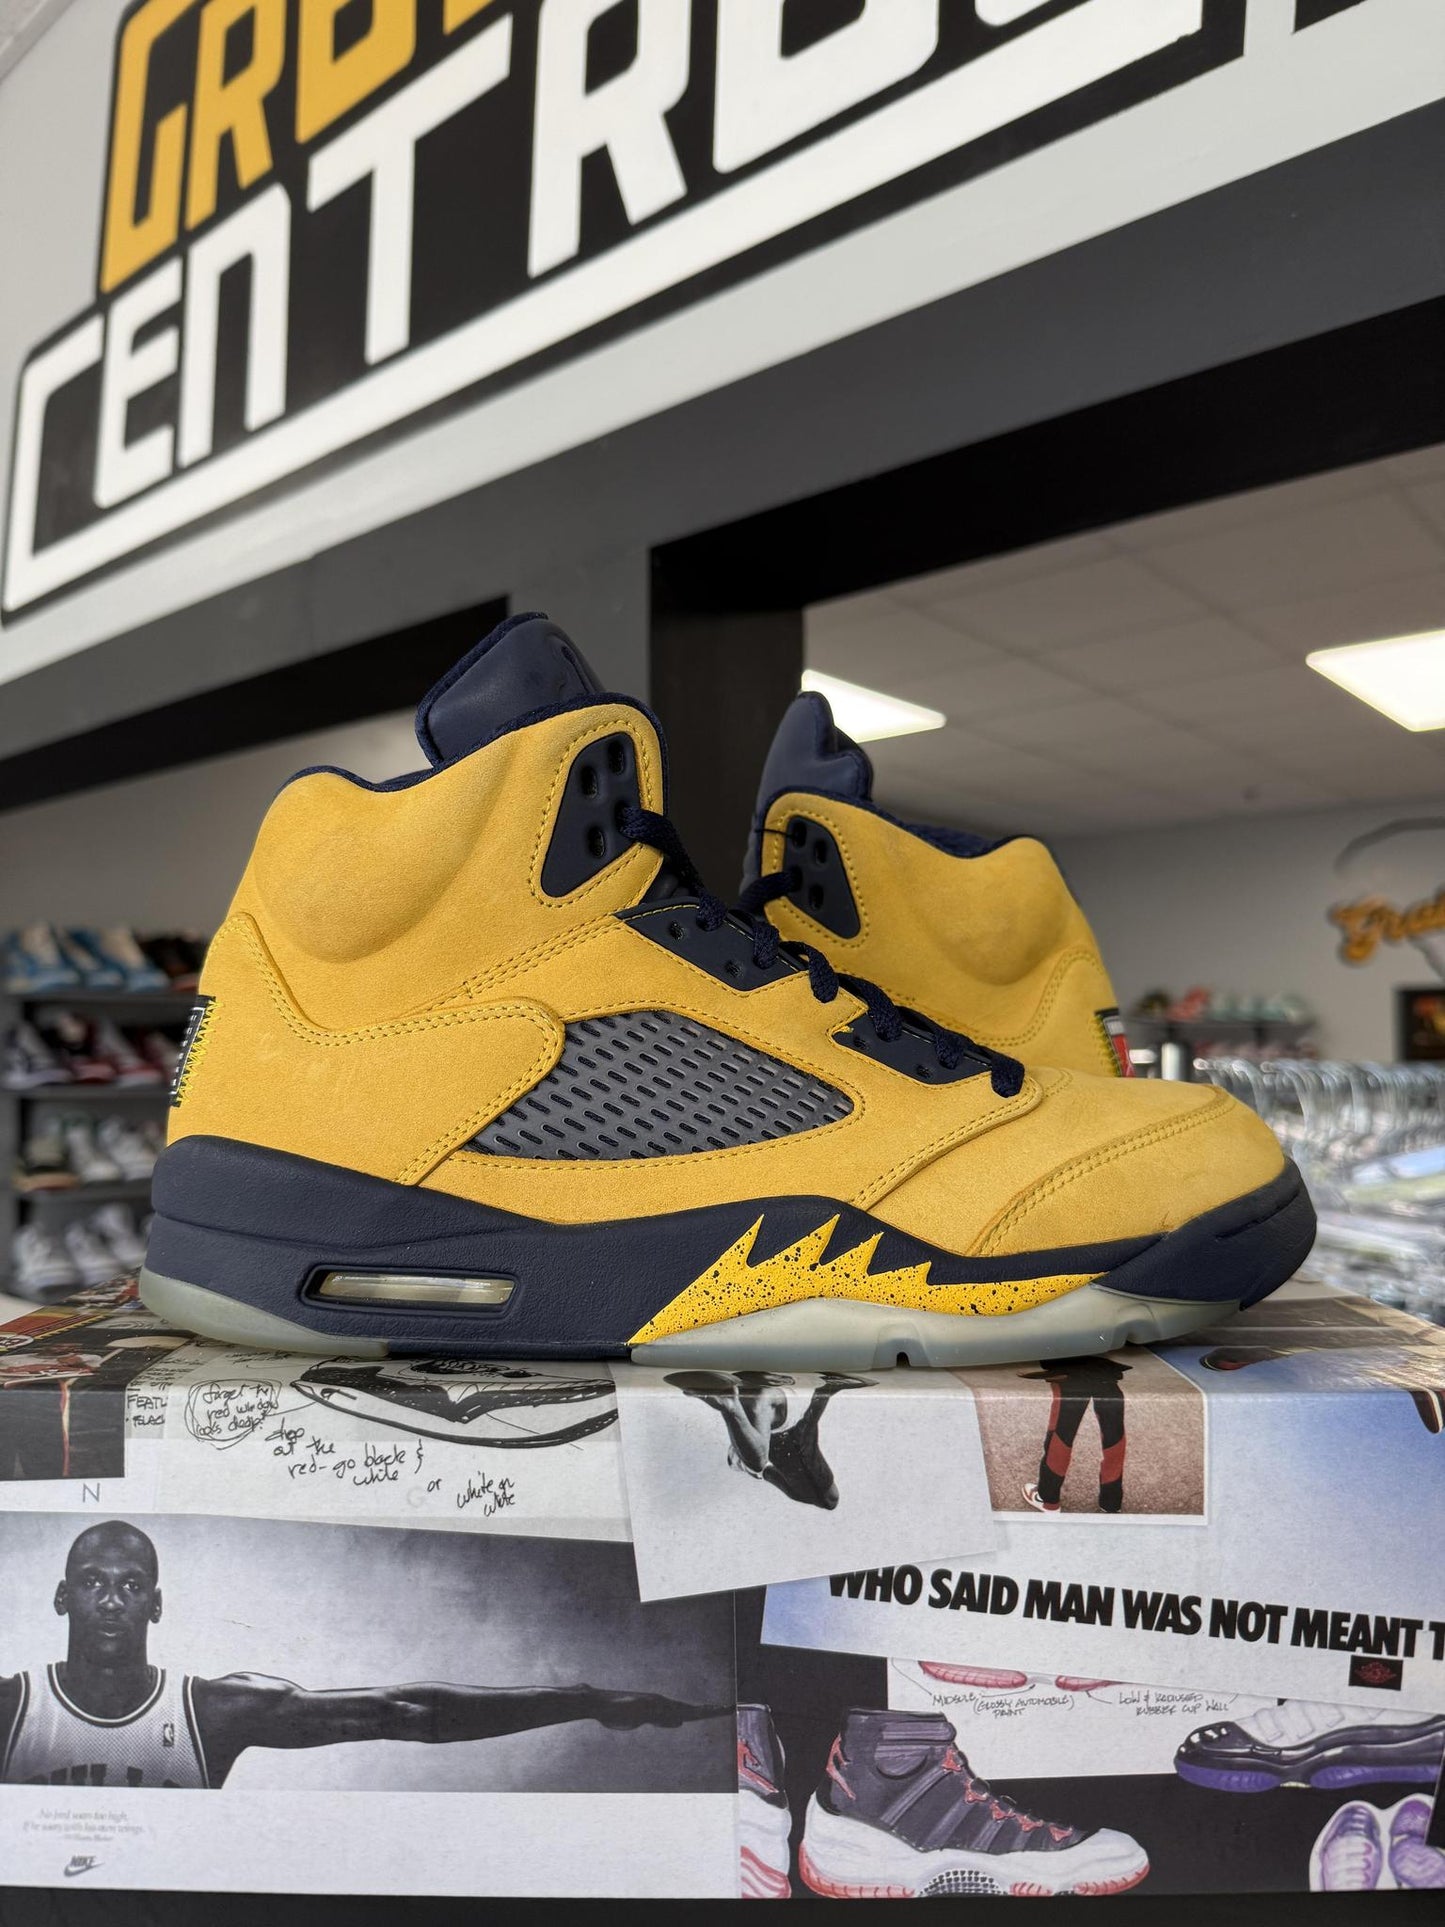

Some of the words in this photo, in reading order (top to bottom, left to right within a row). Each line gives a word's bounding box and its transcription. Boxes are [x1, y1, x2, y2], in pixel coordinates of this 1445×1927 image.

[306, 1436, 336, 1456] the
[364, 1443, 406, 1468] black
[353, 1464, 399, 1486] white
[82, 1482, 101, 1503] N
[427, 1478, 442, 1492] or
[457, 1471, 493, 1509] white
[484, 1490, 516, 1517] white
[829, 1564, 924, 1605] WHO
[928, 1568, 1019, 1615] SAID
[1023, 1578, 1115, 1626] MAN
[1121, 1588, 1202, 1635] WAS
[1209, 1598, 1288, 1644] NOT
[1290, 1607, 1424, 1658] MEANT
[70, 1855, 97, 1867] NIKE
